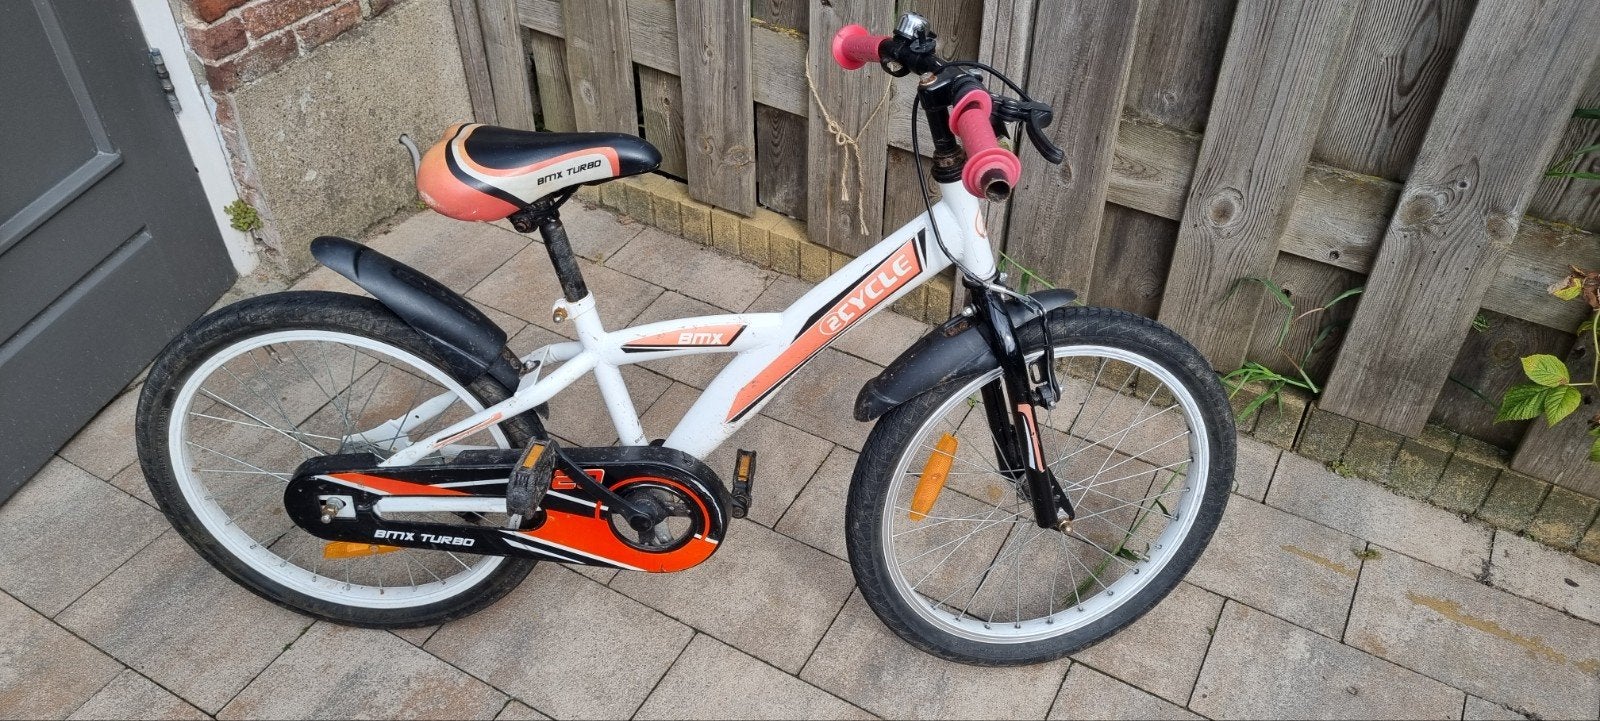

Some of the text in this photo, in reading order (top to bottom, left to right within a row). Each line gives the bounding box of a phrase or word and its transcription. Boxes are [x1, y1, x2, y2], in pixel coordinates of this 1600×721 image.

[537, 159, 602, 186] BMX TURBO
[825, 253, 913, 333] 2CYCLE
[677, 332, 724, 345] BMX
[373, 529, 476, 547] BMX TURBO
